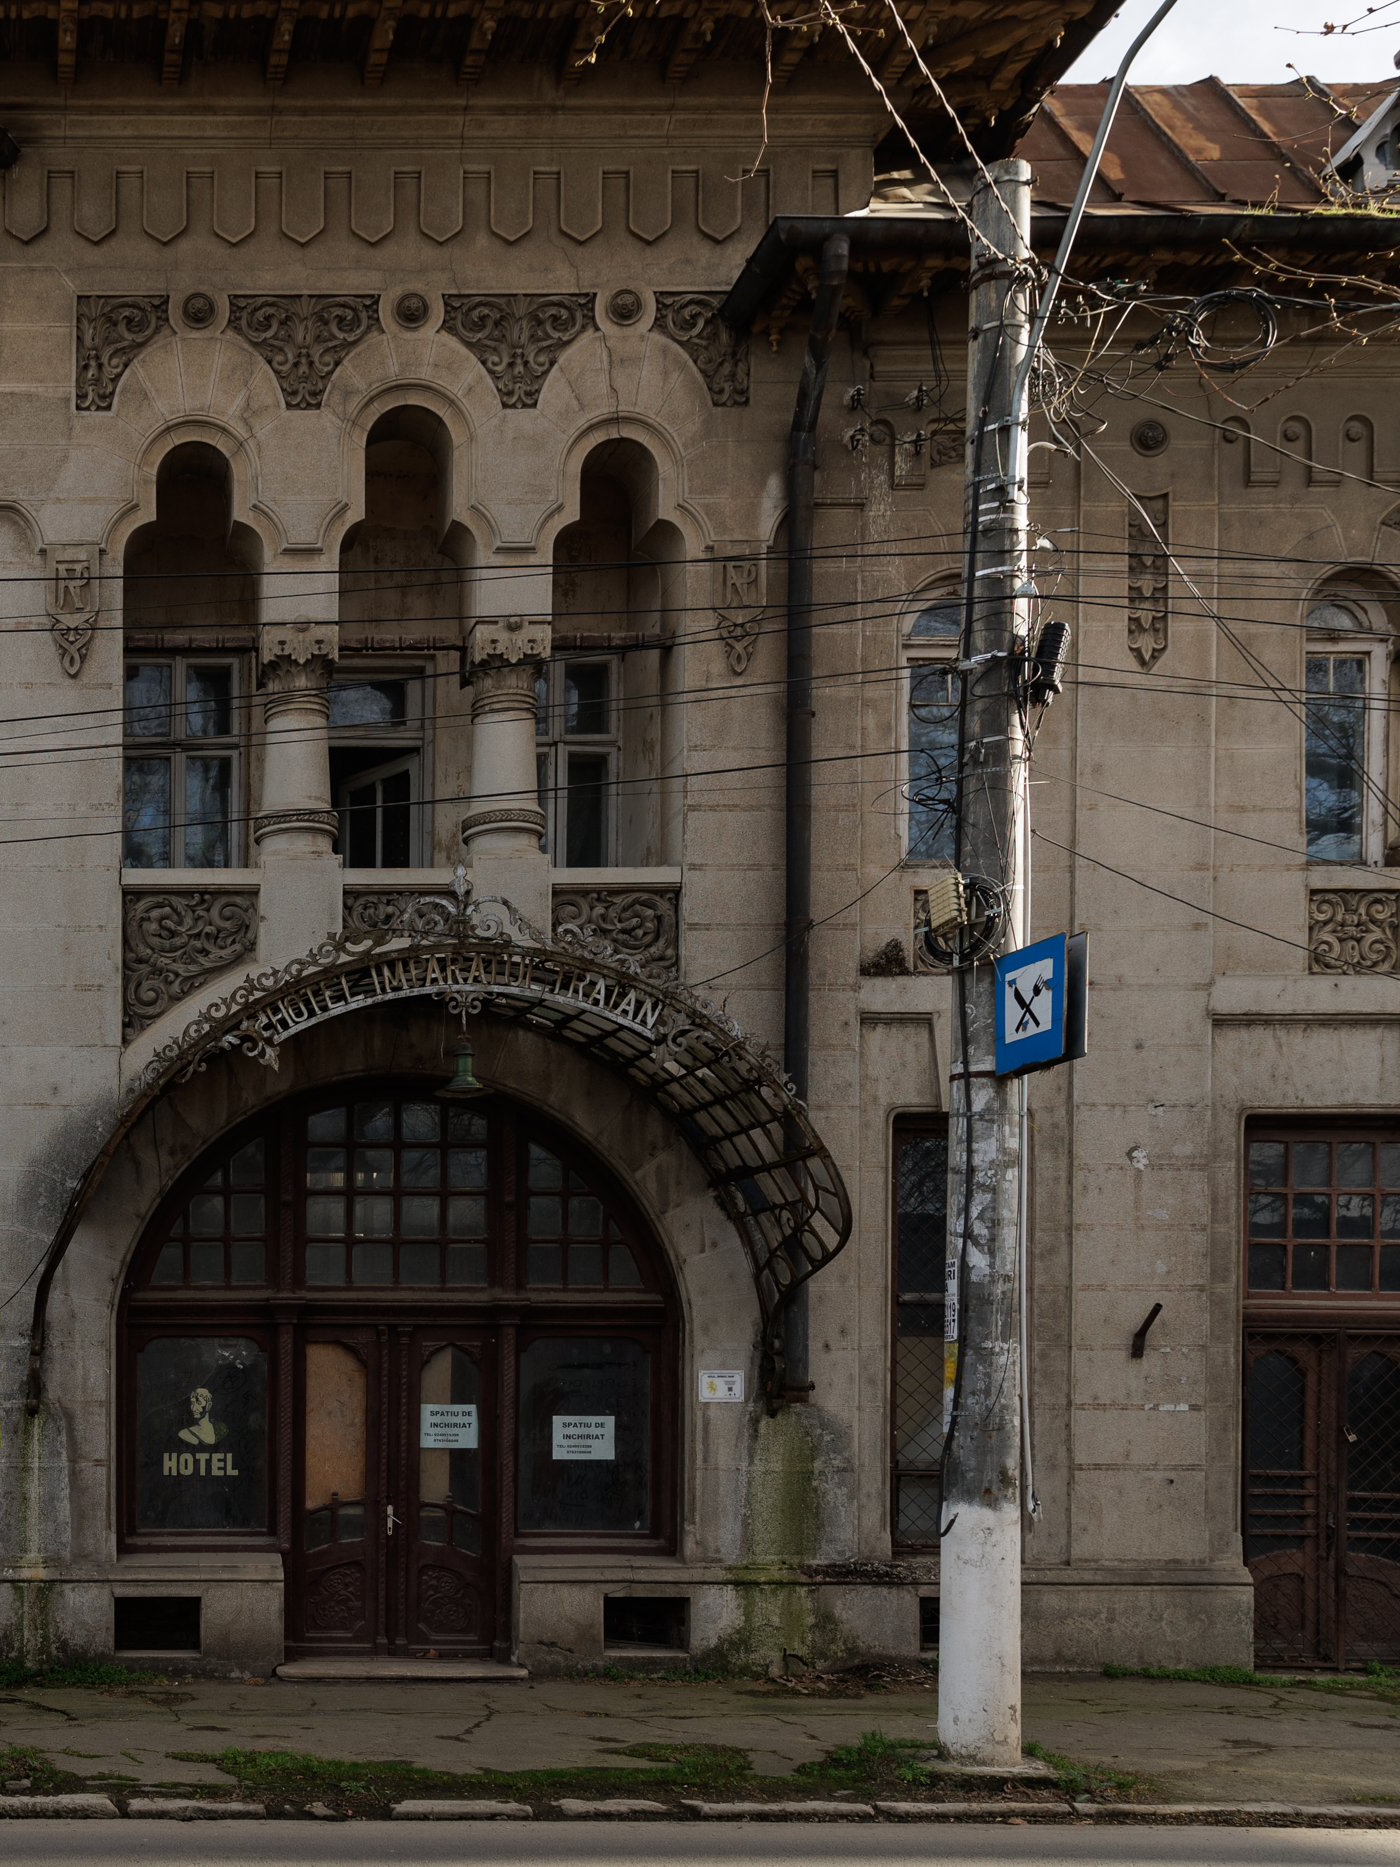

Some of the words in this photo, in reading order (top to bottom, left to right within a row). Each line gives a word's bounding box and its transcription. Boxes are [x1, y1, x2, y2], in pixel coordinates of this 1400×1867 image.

[266, 973, 365, 1033] HOTEL
[370, 953, 547, 996] IMPARATUL
[553, 963, 664, 1030] TRAIAN
[163, 1453, 239, 1476] HOTEL
